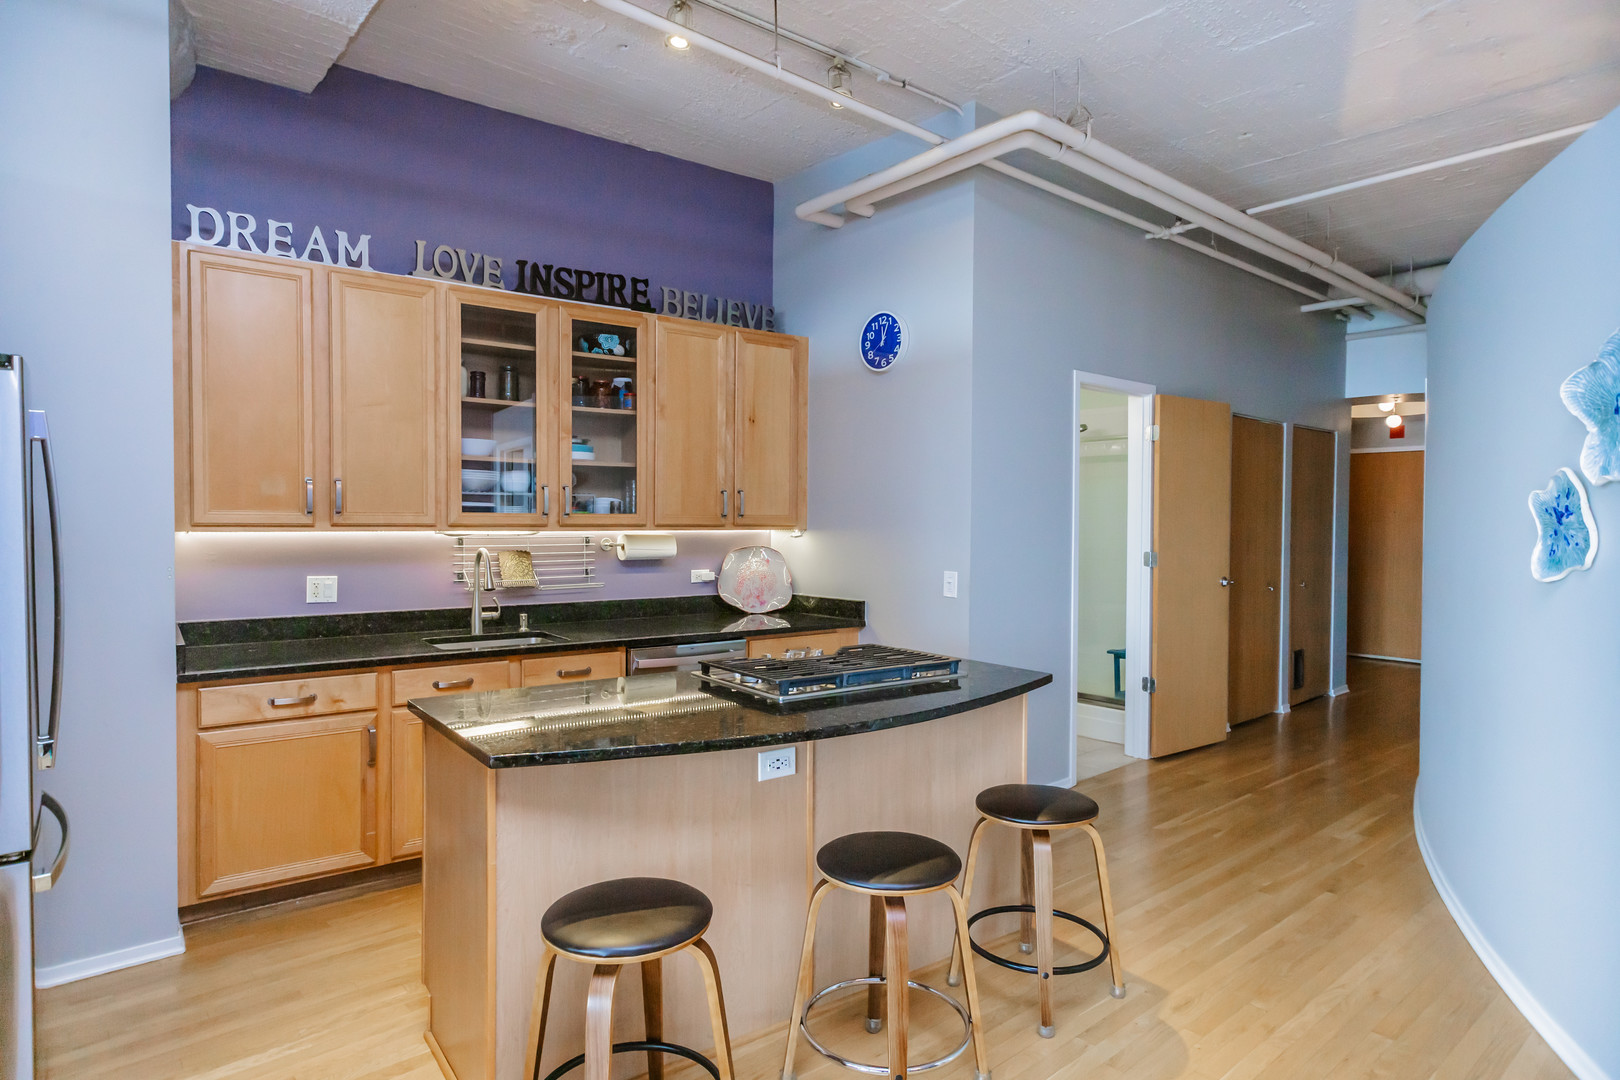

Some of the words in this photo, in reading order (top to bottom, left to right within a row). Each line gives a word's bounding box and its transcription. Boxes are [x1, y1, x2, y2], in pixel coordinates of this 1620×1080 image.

[185, 203, 375, 271] DREAM
[412, 239, 506, 290] LOVE
[513, 260, 657, 313] INSPIRE
[660, 286, 777, 333] BELIEVE
[879, 315, 887, 325] 12
[888, 317, 892, 325] 1
[871, 322, 878, 330] 11
[893, 323, 900, 332] 2
[866, 331, 875, 340] 10
[864, 341, 871, 350] 9
[893, 344, 900, 352] 4
[867, 350, 874, 360] 8
[888, 353, 894, 362] 5
[874, 356, 880, 365] 7
[881, 358, 887, 367] 6
